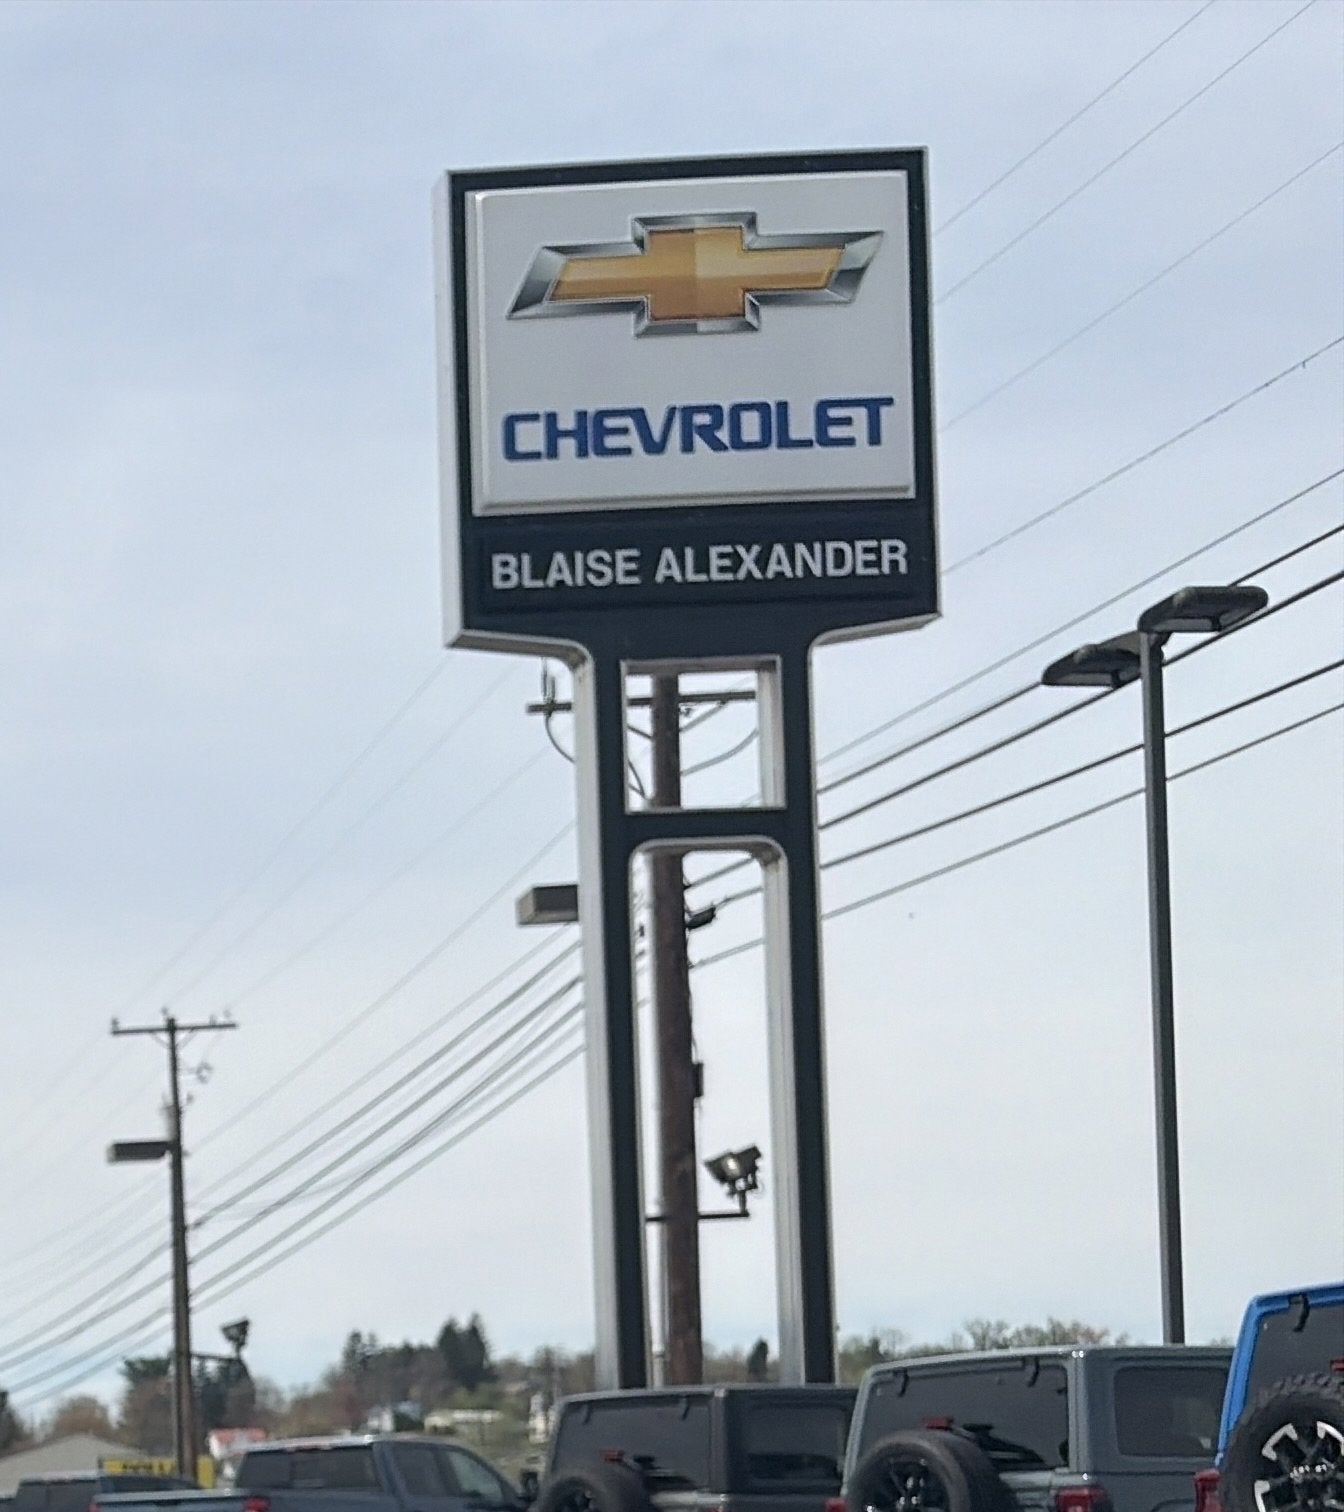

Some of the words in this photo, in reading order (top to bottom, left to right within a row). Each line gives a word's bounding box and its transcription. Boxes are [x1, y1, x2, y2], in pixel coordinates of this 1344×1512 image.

[503, 397, 894, 461] CHEVROLET
[491, 548, 642, 590] BLAISE
[654, 539, 908, 584] ALEXANDER
